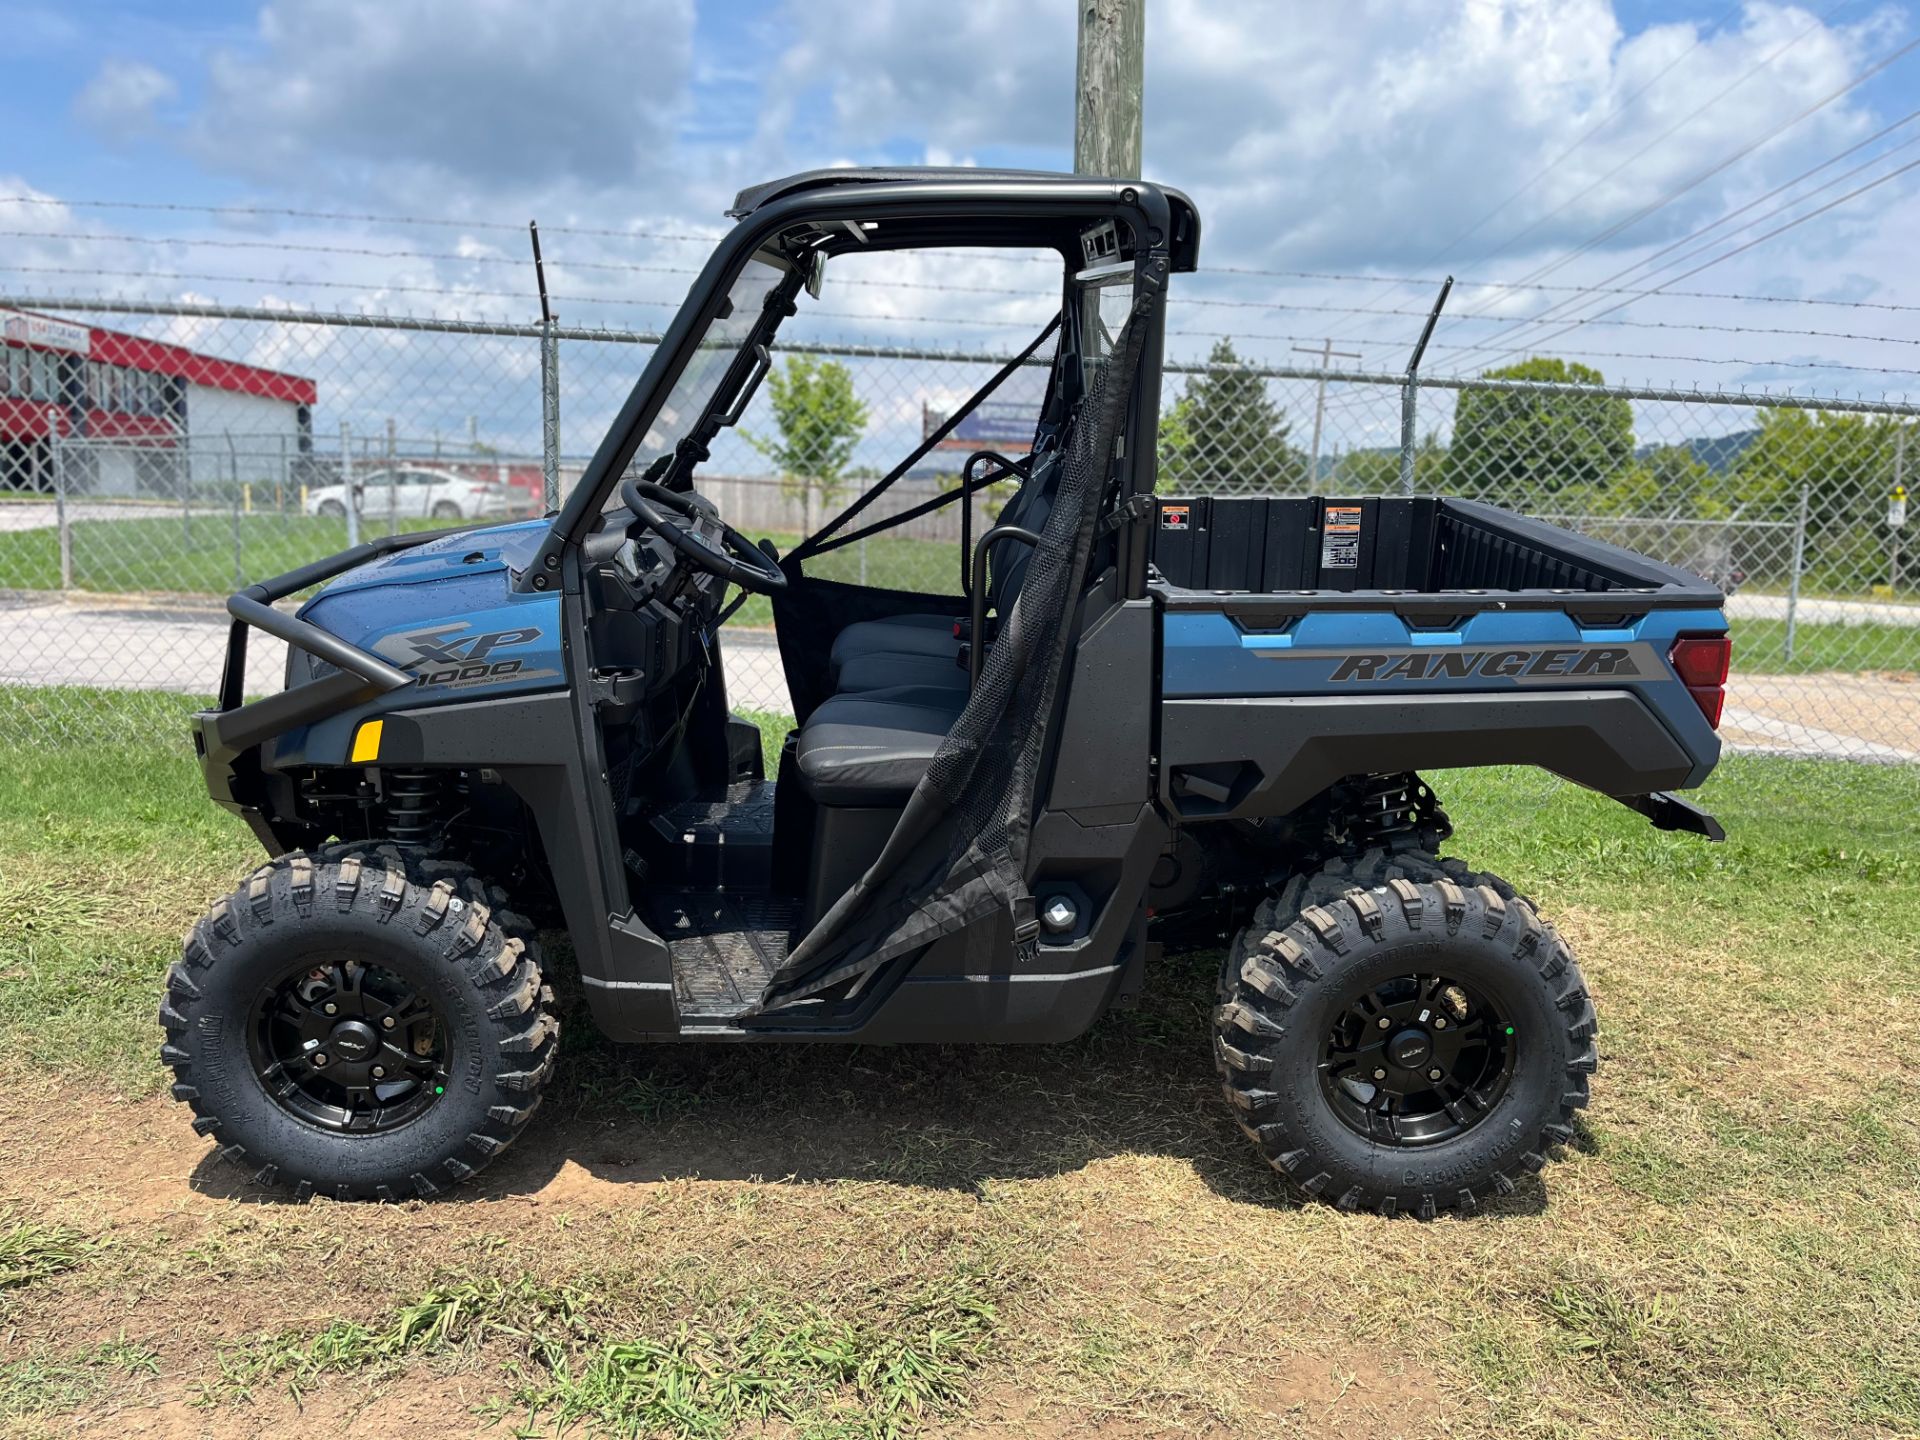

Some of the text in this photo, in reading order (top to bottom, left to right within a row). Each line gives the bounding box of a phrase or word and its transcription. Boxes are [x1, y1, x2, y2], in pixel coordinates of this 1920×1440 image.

[399, 626, 543, 671] XP
[417, 659, 523, 688] 1000
[1328, 649, 1630, 682] RANGER
